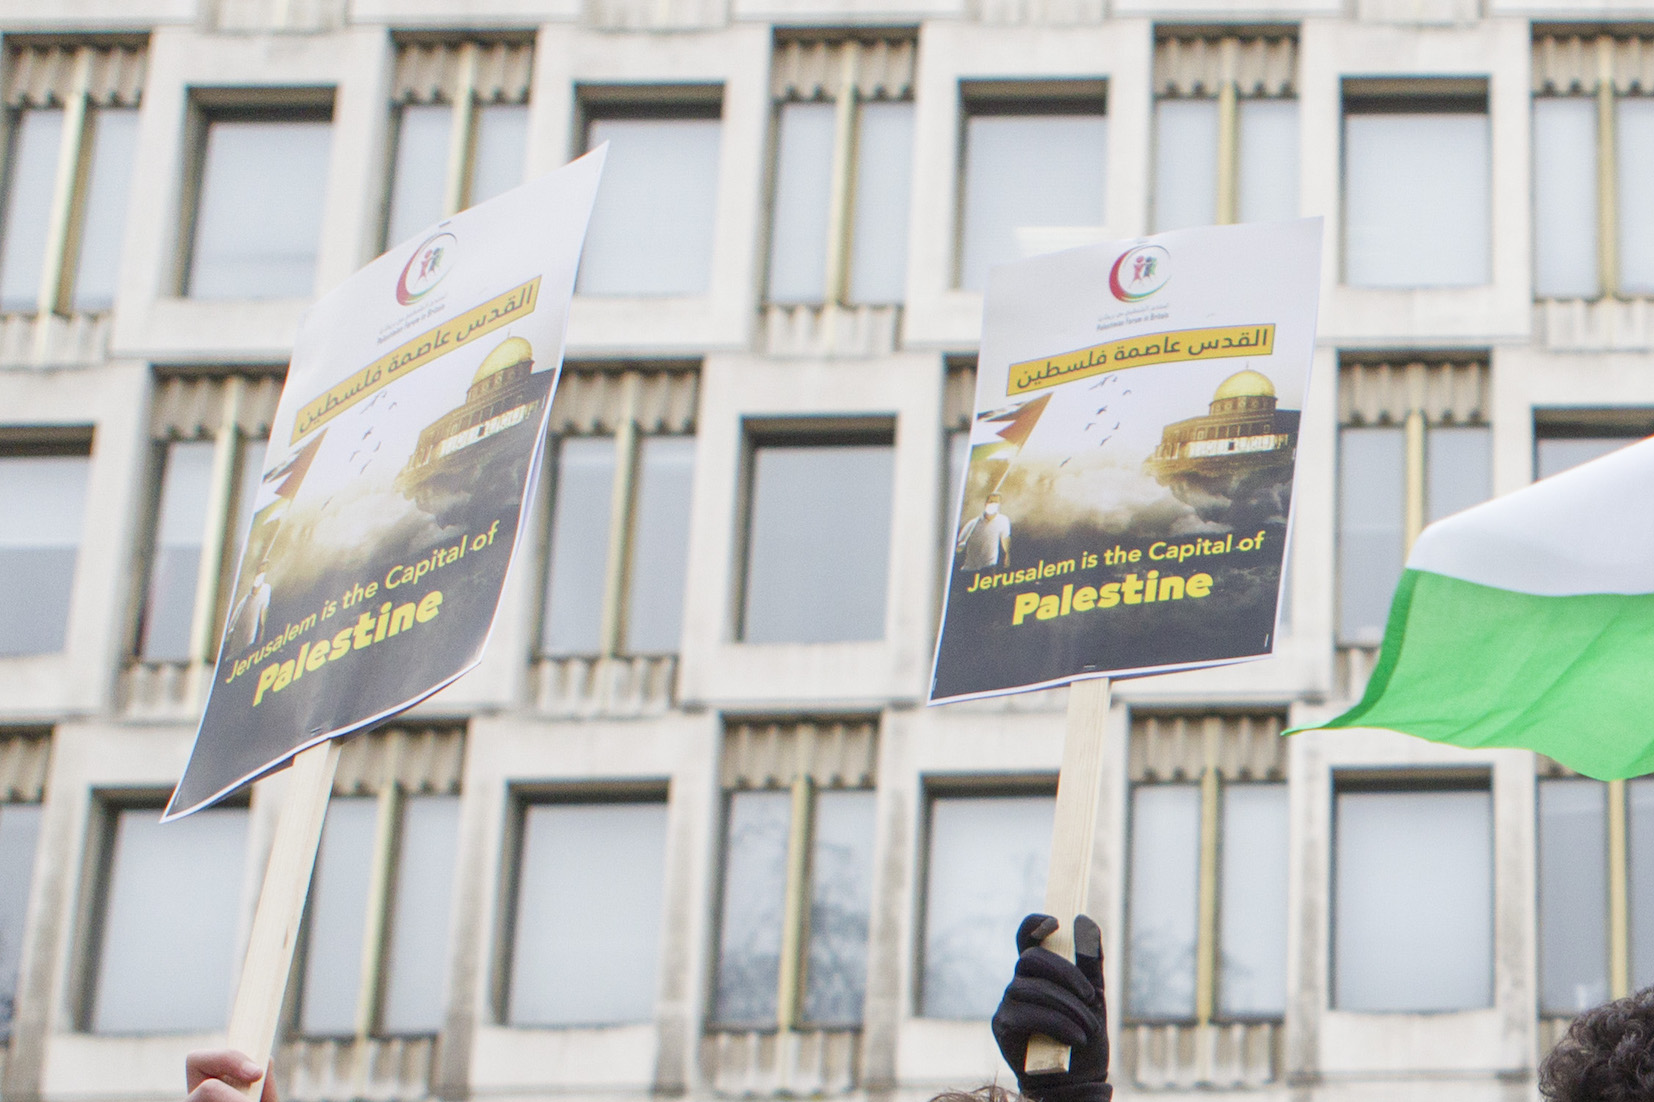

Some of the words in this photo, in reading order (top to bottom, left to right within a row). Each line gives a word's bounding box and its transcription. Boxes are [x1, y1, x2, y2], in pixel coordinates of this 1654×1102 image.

[456, 283, 534, 342] القدس
[387, 329, 451, 374] عاصمة
[1017, 350, 1107, 388] فلسطين
[1114, 336, 1181, 361] عاصمة
[1187, 328, 1268, 355] القدس
[299, 367, 382, 433] فلسطين
[967, 559, 1075, 593] Jerusalem
[1081, 551, 1098, 569] is
[1104, 545, 1142, 566] the
[1148, 533, 1233, 563] Capital
[1238, 530, 1266, 551] of
[225, 612, 317, 684] Jerusalem
[320, 600, 338, 622] is
[342, 581, 379, 609] the
[384, 534, 468, 590] Capital
[472, 519, 500, 551] of
[1011, 569, 1214, 625] Palestine
[252, 590, 444, 708] Palestine
